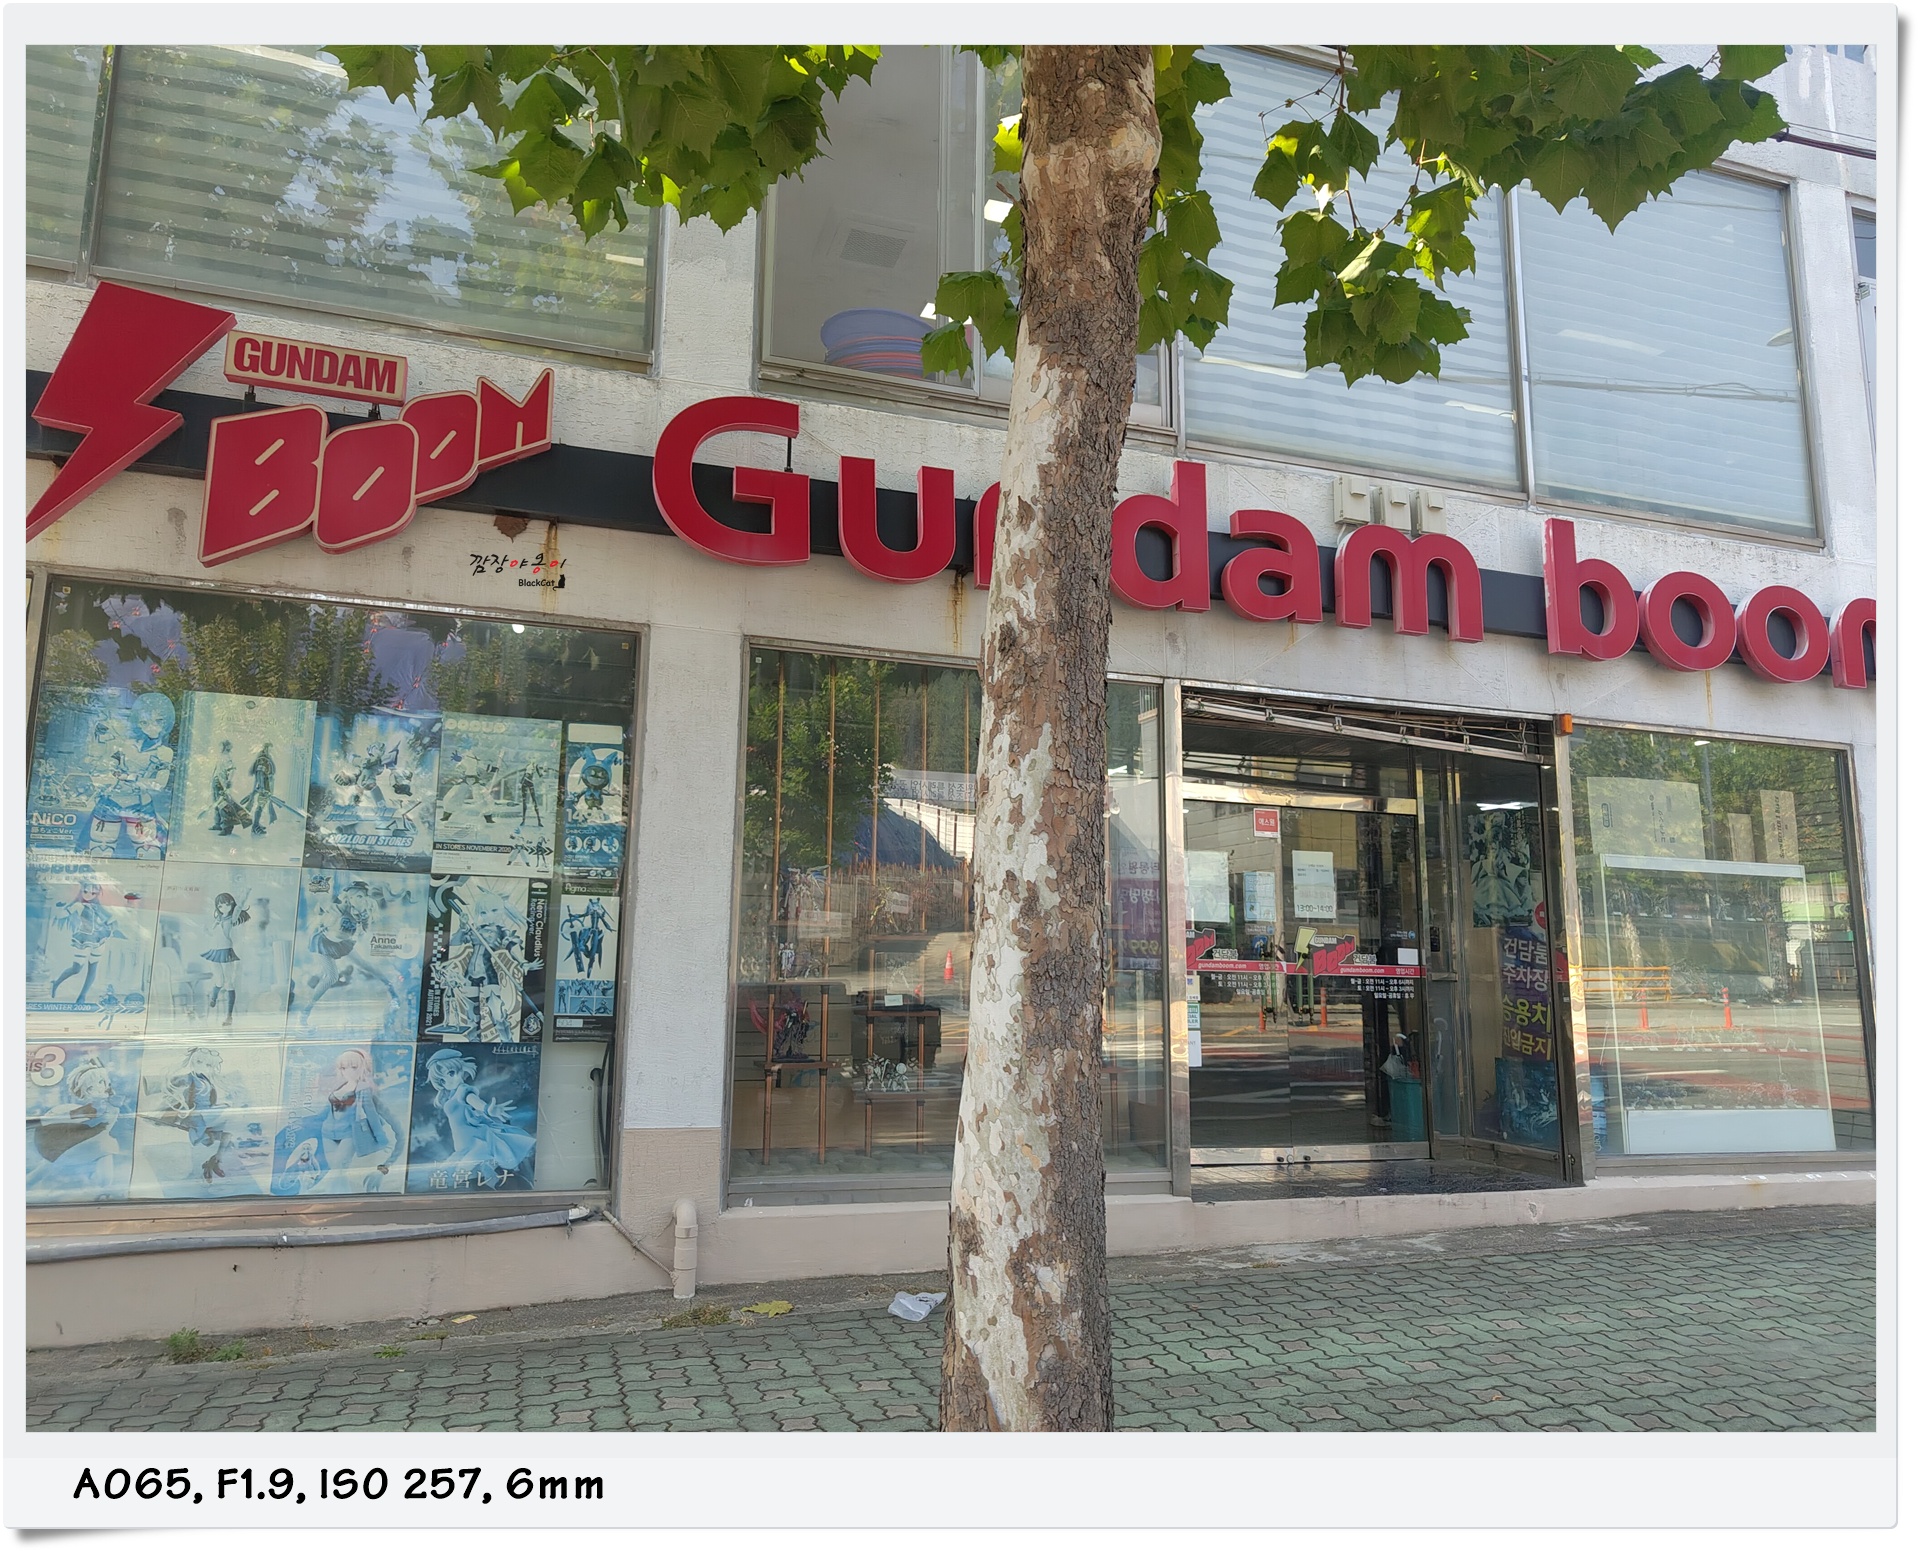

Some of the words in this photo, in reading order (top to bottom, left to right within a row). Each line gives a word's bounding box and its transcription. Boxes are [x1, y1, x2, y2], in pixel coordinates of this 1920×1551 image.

[233, 337, 398, 395] GUNDAM
[199, 368, 554, 567] BOOM
[378, 837, 413, 847] STORES
[536, 898, 546, 918] Nero
[370, 936, 397, 944] Anne
[534, 920, 544, 958] Claudius
[43, 1003, 73, 1011] WINTER
[430, 1169, 515, 1190] 竜宮レナ
